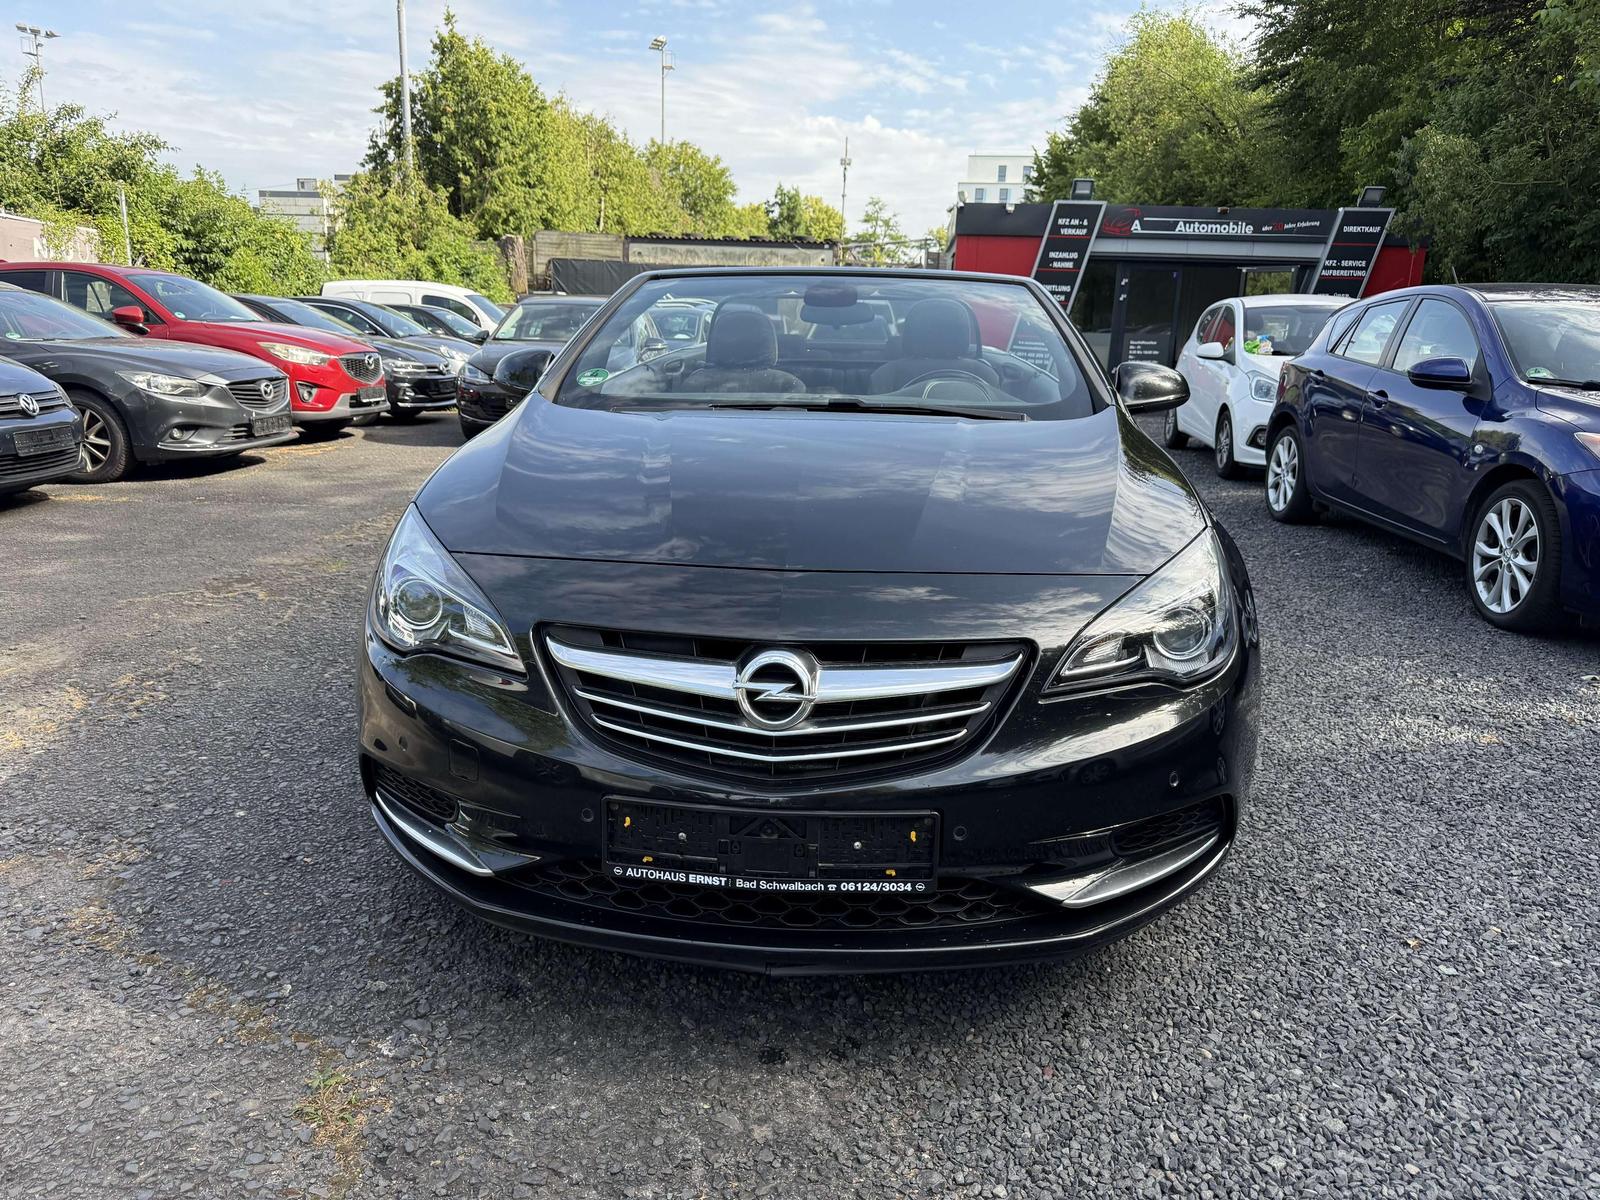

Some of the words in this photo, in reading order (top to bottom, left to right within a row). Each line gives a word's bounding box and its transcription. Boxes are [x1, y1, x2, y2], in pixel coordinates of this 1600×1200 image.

[1175, 221, 1254, 234] Automobile
[625, 867, 686, 882] AUTOHAUS
[688, 873, 727, 886] ERNST
[735, 878, 757, 889] Bad
[759, 880, 825, 891] Schwalbach
[840, 882, 913, 892] 06124/3034
